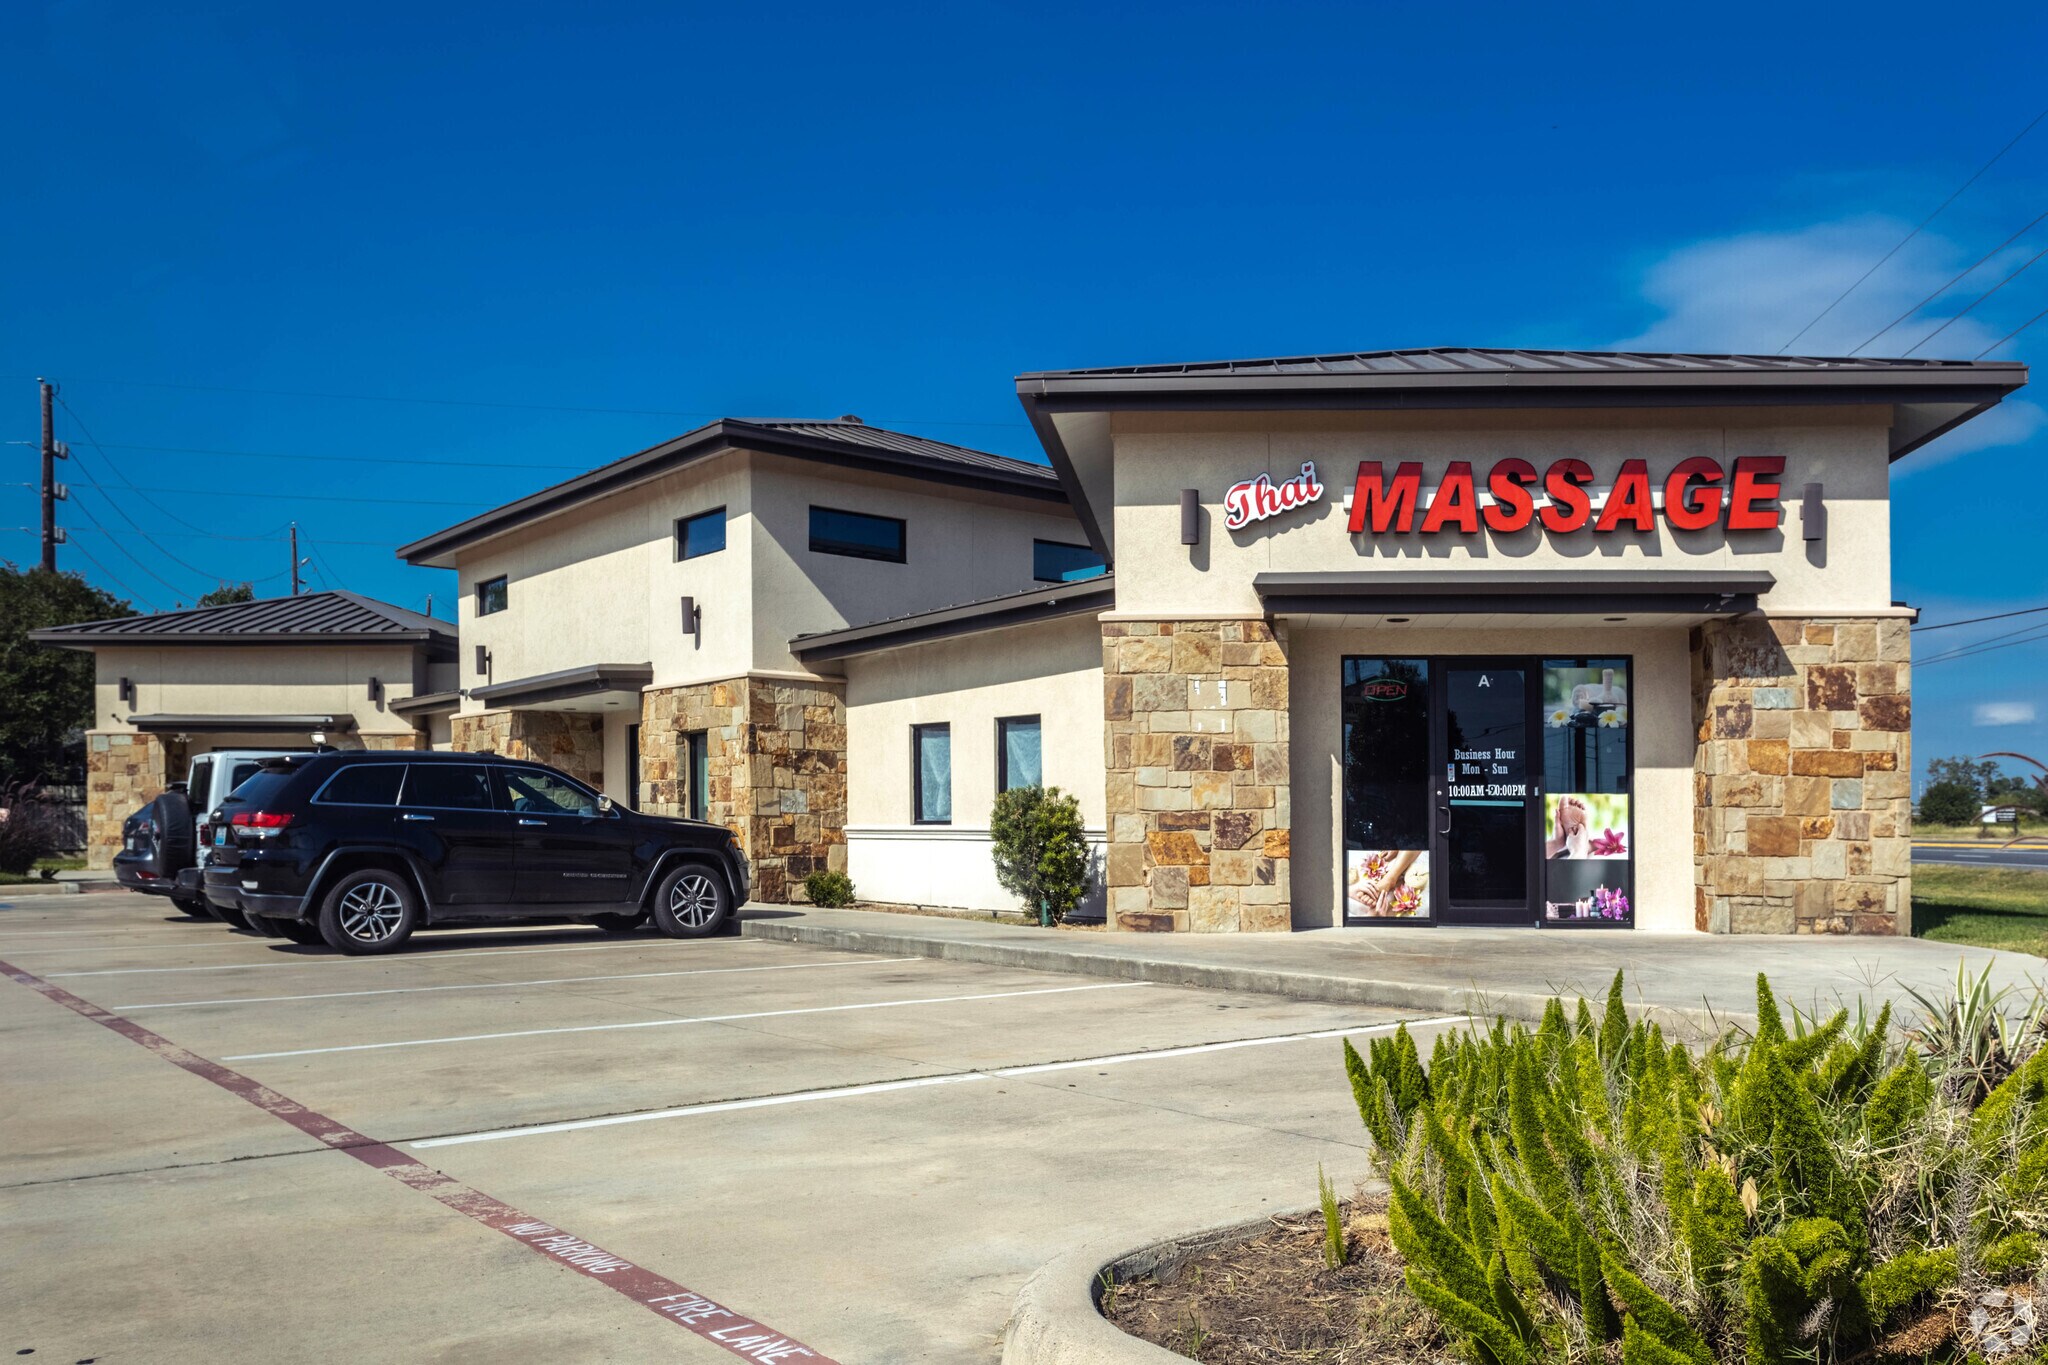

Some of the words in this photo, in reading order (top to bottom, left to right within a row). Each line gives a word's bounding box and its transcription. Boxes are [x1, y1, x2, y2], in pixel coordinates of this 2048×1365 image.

[1225, 462, 1323, 528] Thai
[1347, 456, 1787, 535] MASSAGE
[1478, 674, 1490, 688] A
[1364, 684, 1408, 697] OPEN
[1454, 749, 1491, 760] Business
[1495, 748, 1516, 760] Hour
[1462, 763, 1480, 775] Mon
[1492, 763, 1509, 775] Sun
[504, 1221, 556, 1236] NO
[531, 1234, 634, 1274] PARKING
[647, 1292, 734, 1325] FIRE
[709, 1323, 815, 1365] LANE
